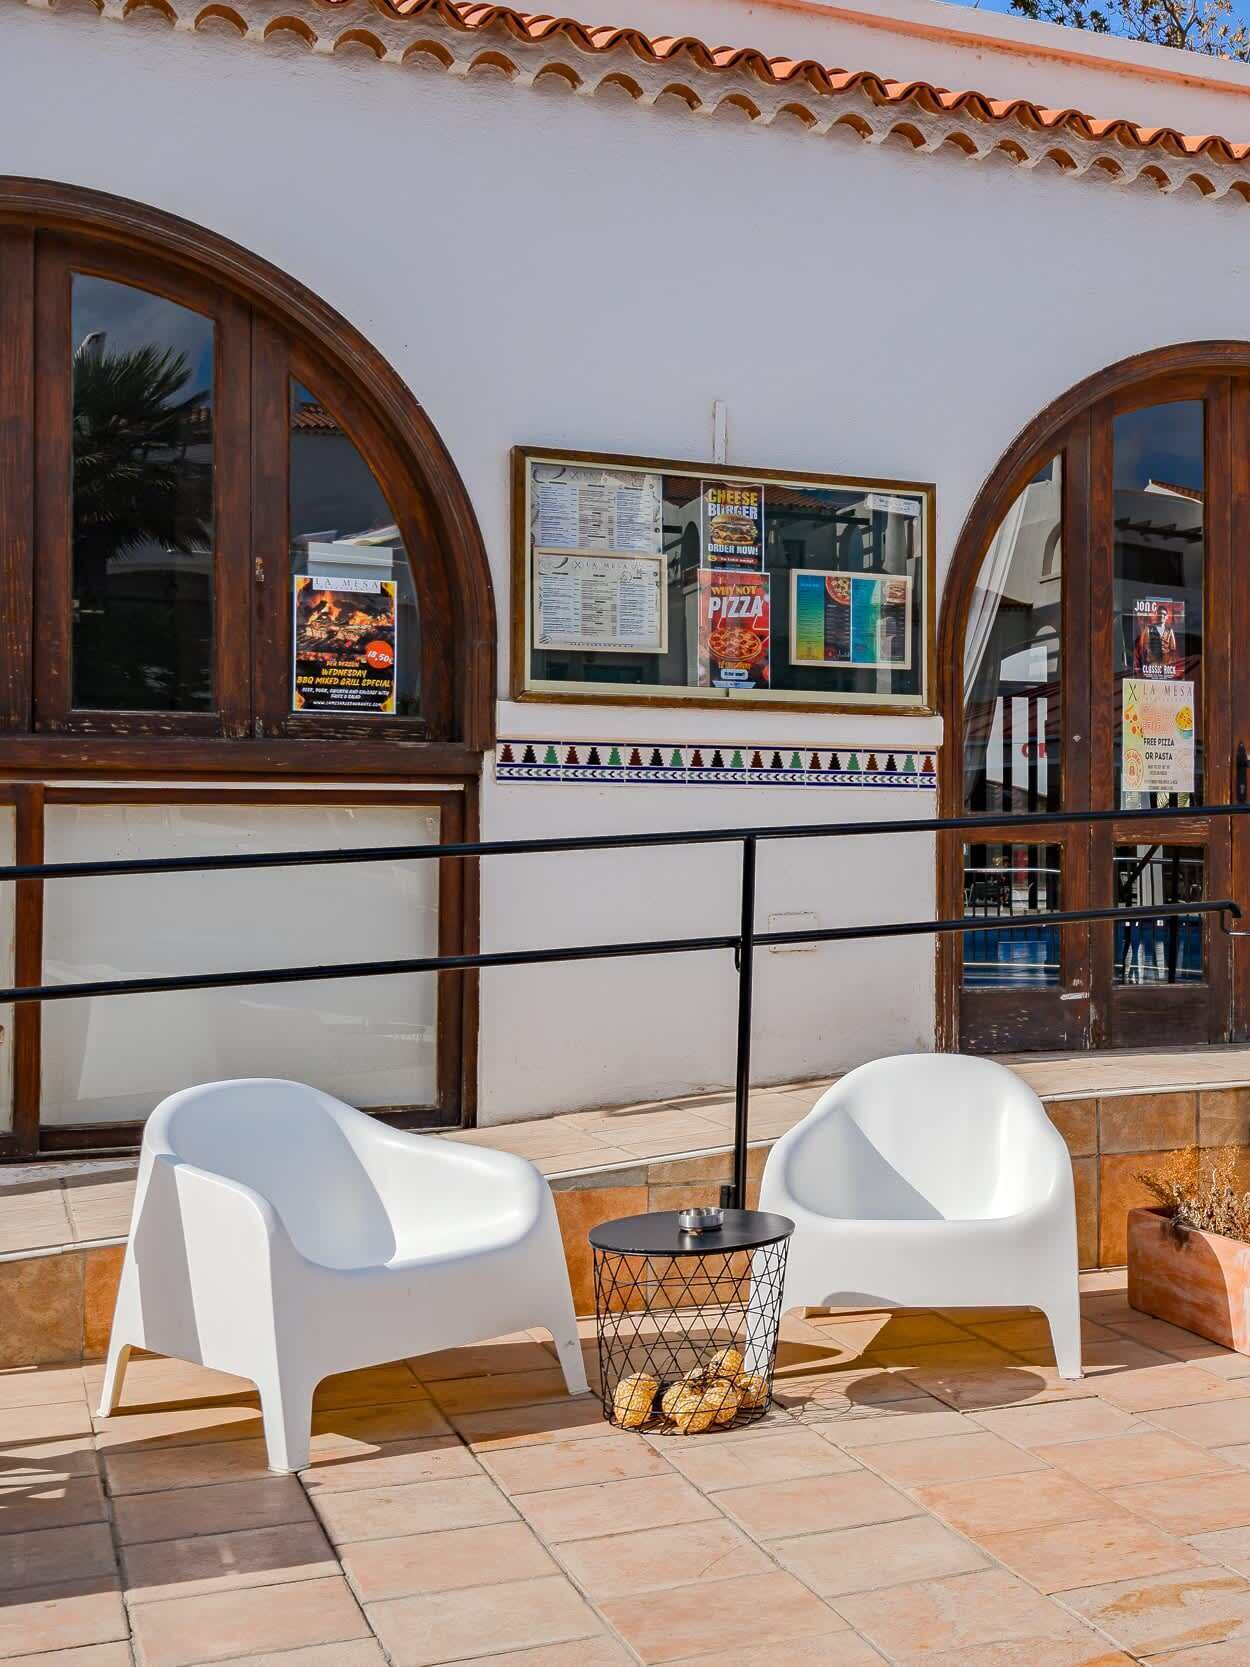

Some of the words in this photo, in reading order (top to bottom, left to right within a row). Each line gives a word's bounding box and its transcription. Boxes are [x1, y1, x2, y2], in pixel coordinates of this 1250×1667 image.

[708, 488, 758, 506] CHEESE
[708, 503, 758, 520] BURGER
[707, 543, 735, 554] ORDER
[736, 545, 759, 555] NOW!
[711, 586, 734, 595] WHY
[736, 585, 758, 595] NOT
[708, 596, 763, 618] PIZZA
[321, 669, 367, 678] WEDNESDAY
[1142, 664, 1163, 674] CLASSIC
[1164, 665, 1177, 675] ROCK
[297, 676, 314, 684] BBQ
[315, 677, 339, 685] MIXED
[340, 678, 361, 686] GRILL
[1143, 684, 1155, 695] LA
[1164, 685, 1193, 697] MESA
[1143, 737, 1156, 746] FREE
[1158, 738, 1175, 747] PIZZA
[1145, 752, 1154, 760] OR
[1154, 752, 1173, 761] PASTA
